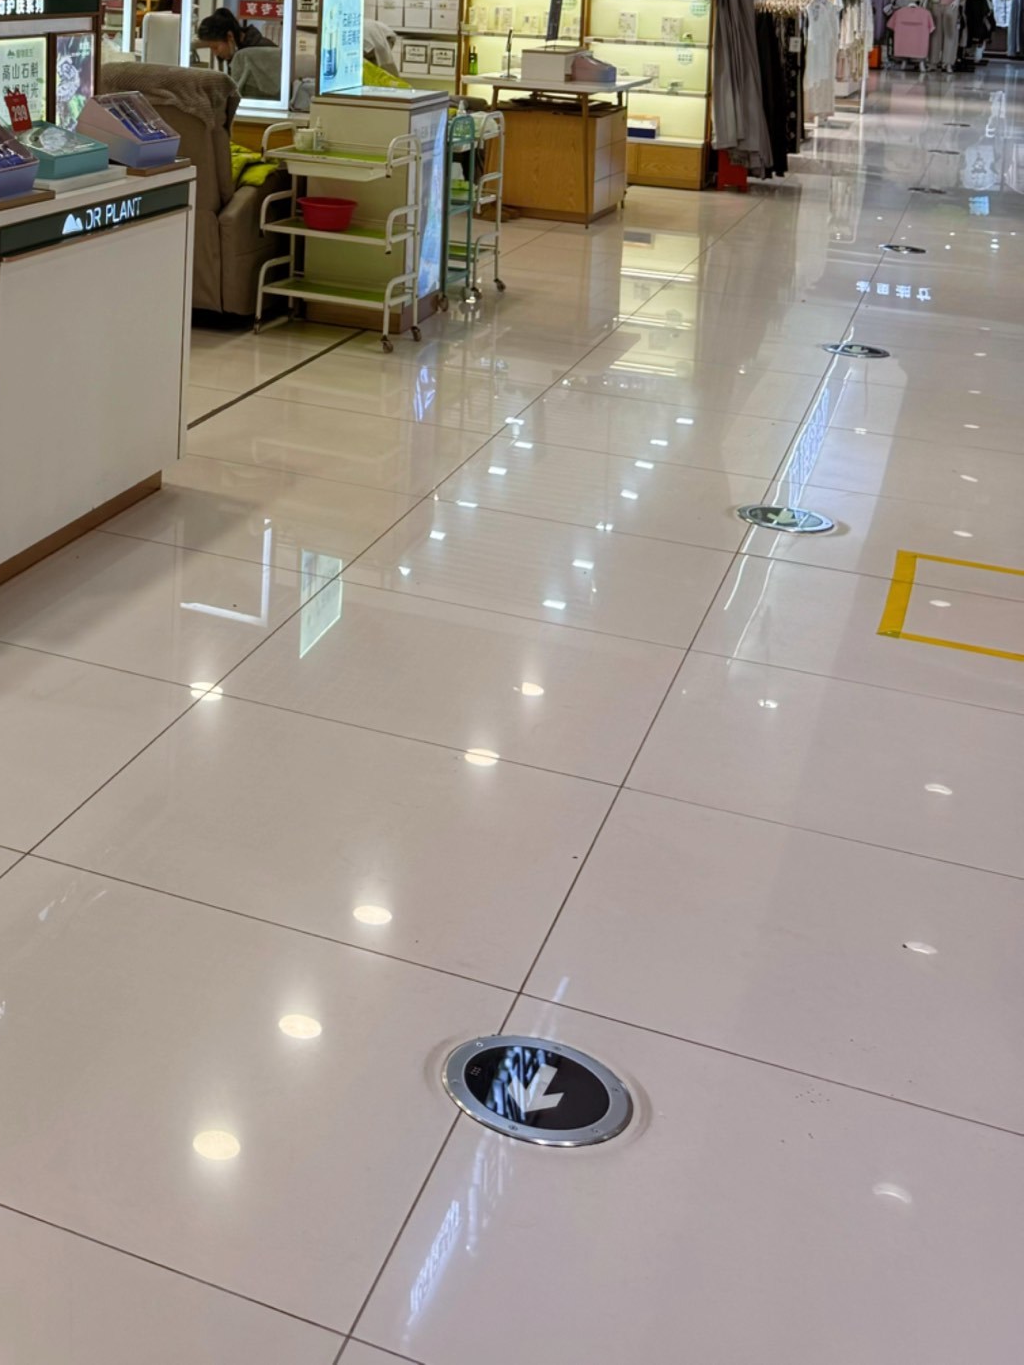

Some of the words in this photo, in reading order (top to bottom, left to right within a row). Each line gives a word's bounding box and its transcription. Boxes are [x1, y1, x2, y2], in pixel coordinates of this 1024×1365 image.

[2, 61, 39, 82] 高山石斛
[85, 206, 101, 230] DR
[106, 197, 142, 225] PLANT
